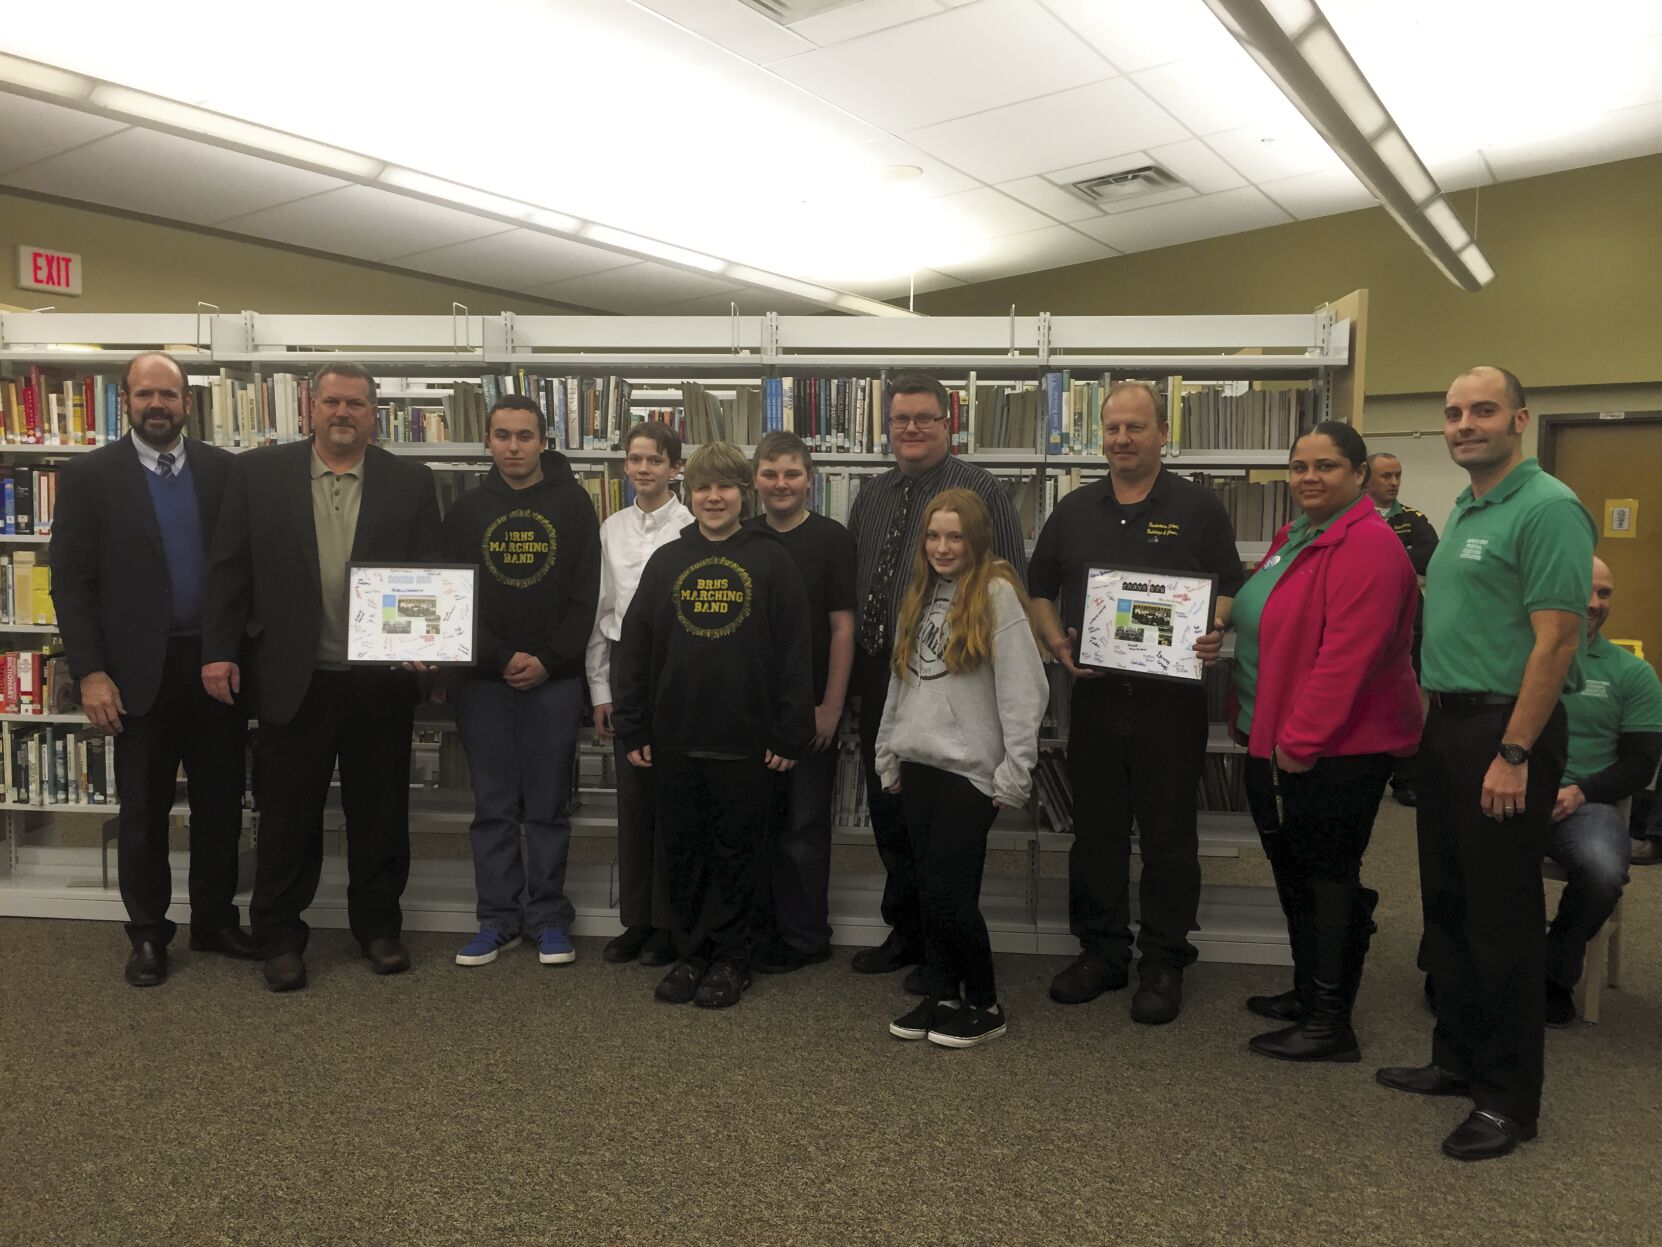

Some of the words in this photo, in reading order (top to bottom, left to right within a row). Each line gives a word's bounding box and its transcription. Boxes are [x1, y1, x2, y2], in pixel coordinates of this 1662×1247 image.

[32, 252, 72, 288] EXIT
[490, 541, 549, 553] MARCHING
[504, 553, 534, 564] BAND
[697, 578, 729, 590] BRHS
[681, 590, 744, 603] MARCHING
[694, 601, 729, 613] BAND
